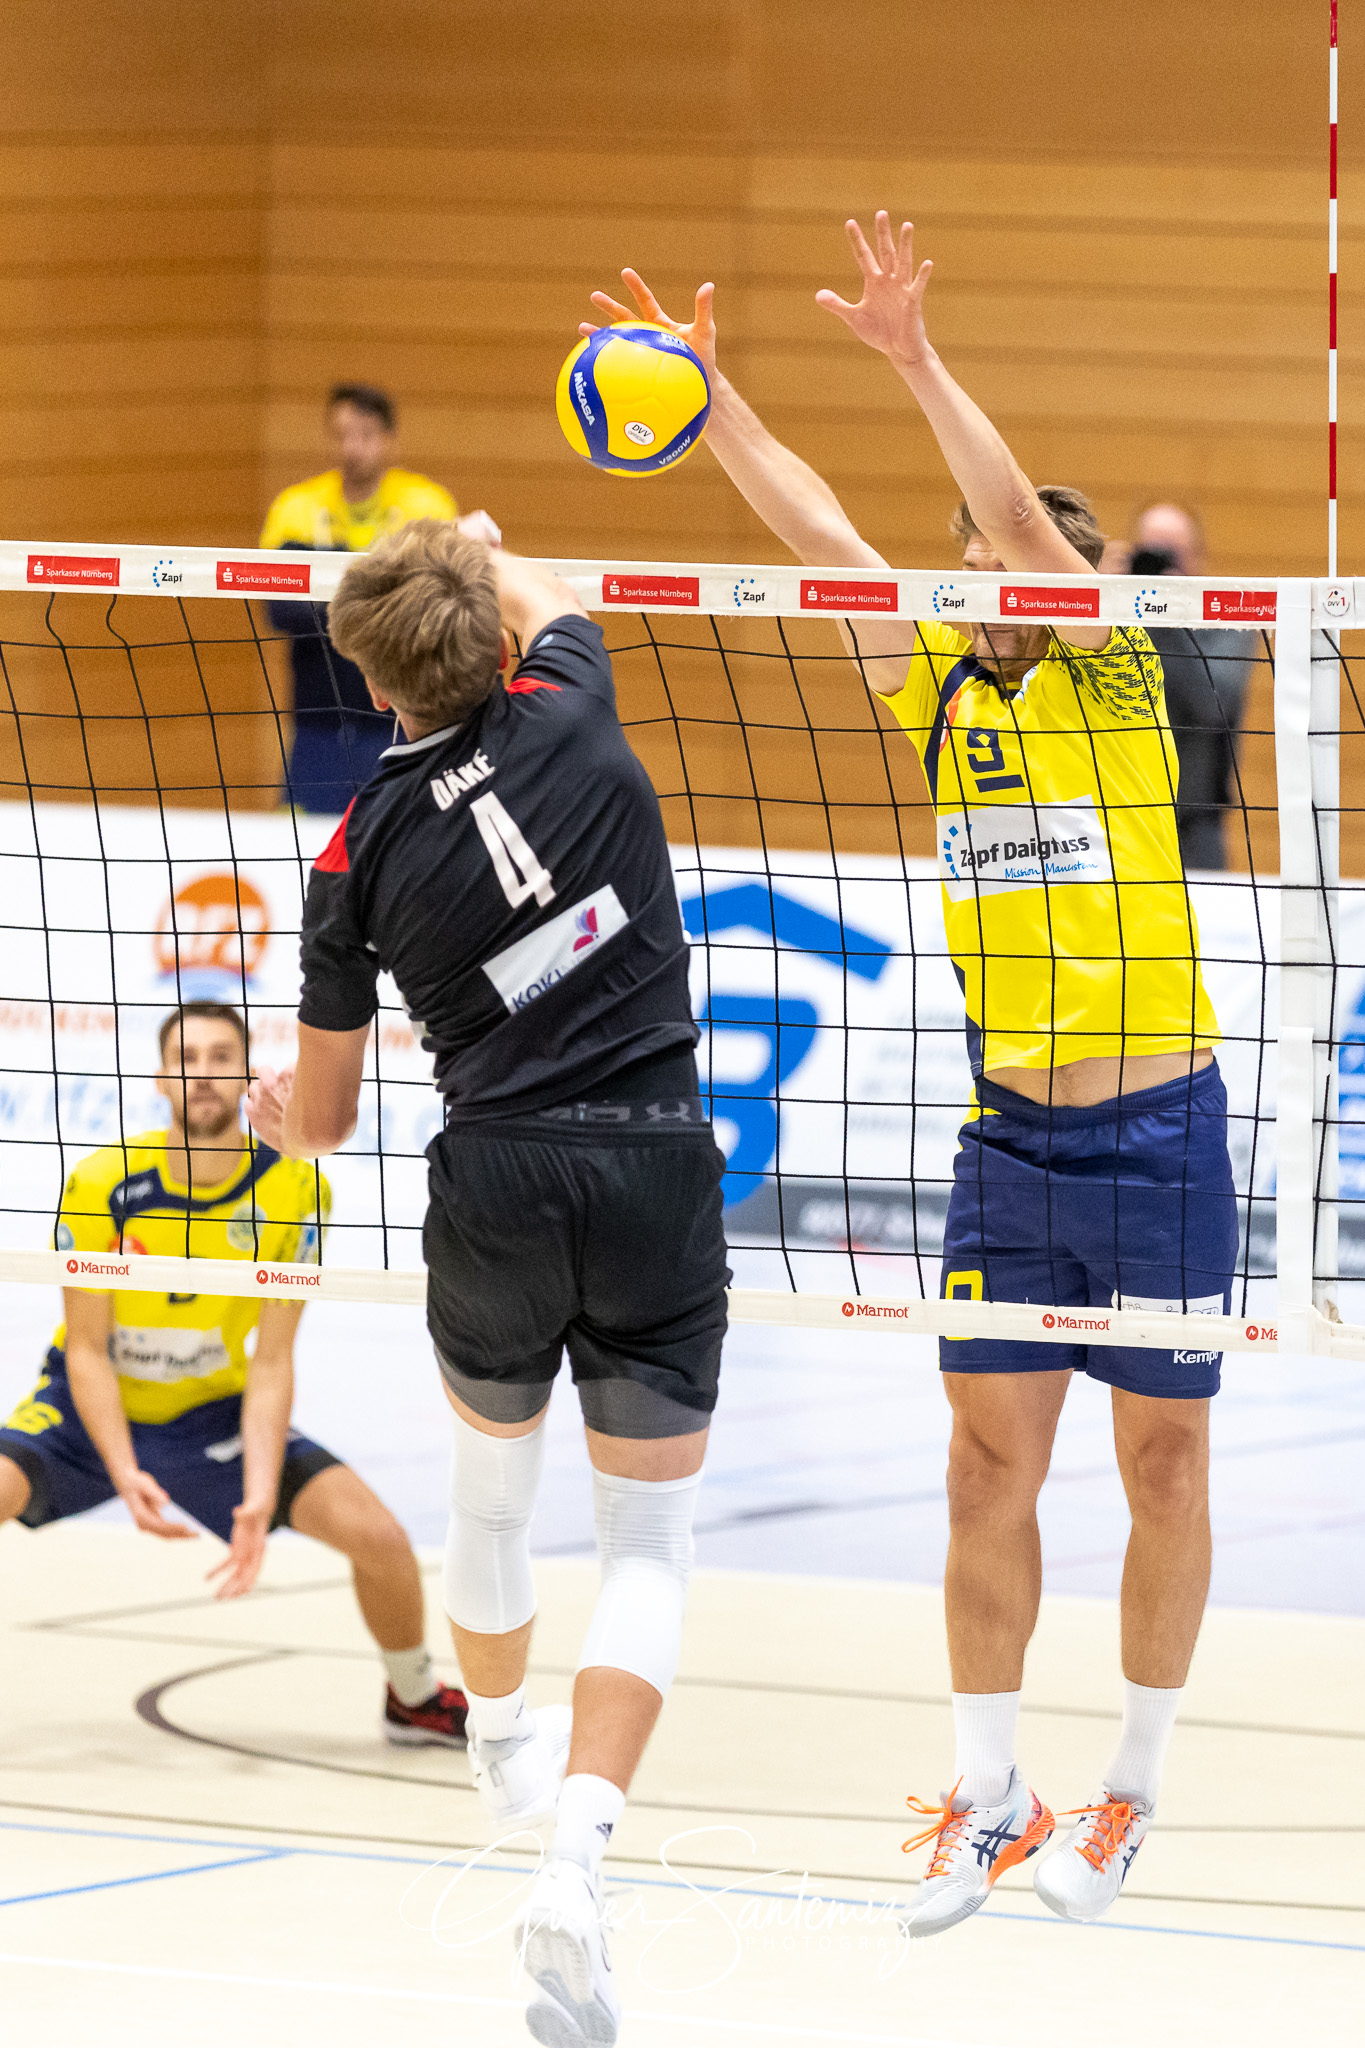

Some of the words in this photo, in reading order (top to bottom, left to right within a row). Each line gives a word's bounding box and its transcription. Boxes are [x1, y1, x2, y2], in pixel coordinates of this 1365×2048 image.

[631, 424, 652, 437] DVV
[658, 436, 691, 466] V200W
[46, 568, 80, 579] Sparkasse
[81, 569, 113, 580] Nürnberg
[161, 573, 183, 583] Zapf
[235, 574, 270, 585] Sparkasse
[271, 576, 304, 587] Nürnberg
[623, 587, 658, 597] Sparkasse
[660, 589, 693, 600] Nürnberg
[743, 592, 766, 603] Zapf
[820, 593, 856, 603] Sparkasse
[858, 595, 891, 605] Nürnberg
[942, 597, 965, 608] Zapf
[1020, 599, 1057, 609] Sparkasse
[1059, 600, 1093, 611] Nürnberg
[1144, 602, 1168, 614] Zapf
[1224, 604, 1260, 614] Sparkasse
[429, 748, 496, 811] DÄKE
[469, 790, 557, 910] 4
[960, 843, 1000, 869] Zapf
[1004, 867, 1042, 879] Mission
[81, 1261, 131, 1276] Marmot
[270, 1272, 321, 1287] Marmot
[856, 1304, 909, 1319] Marmot
[1057, 1316, 1111, 1331] Marmot
